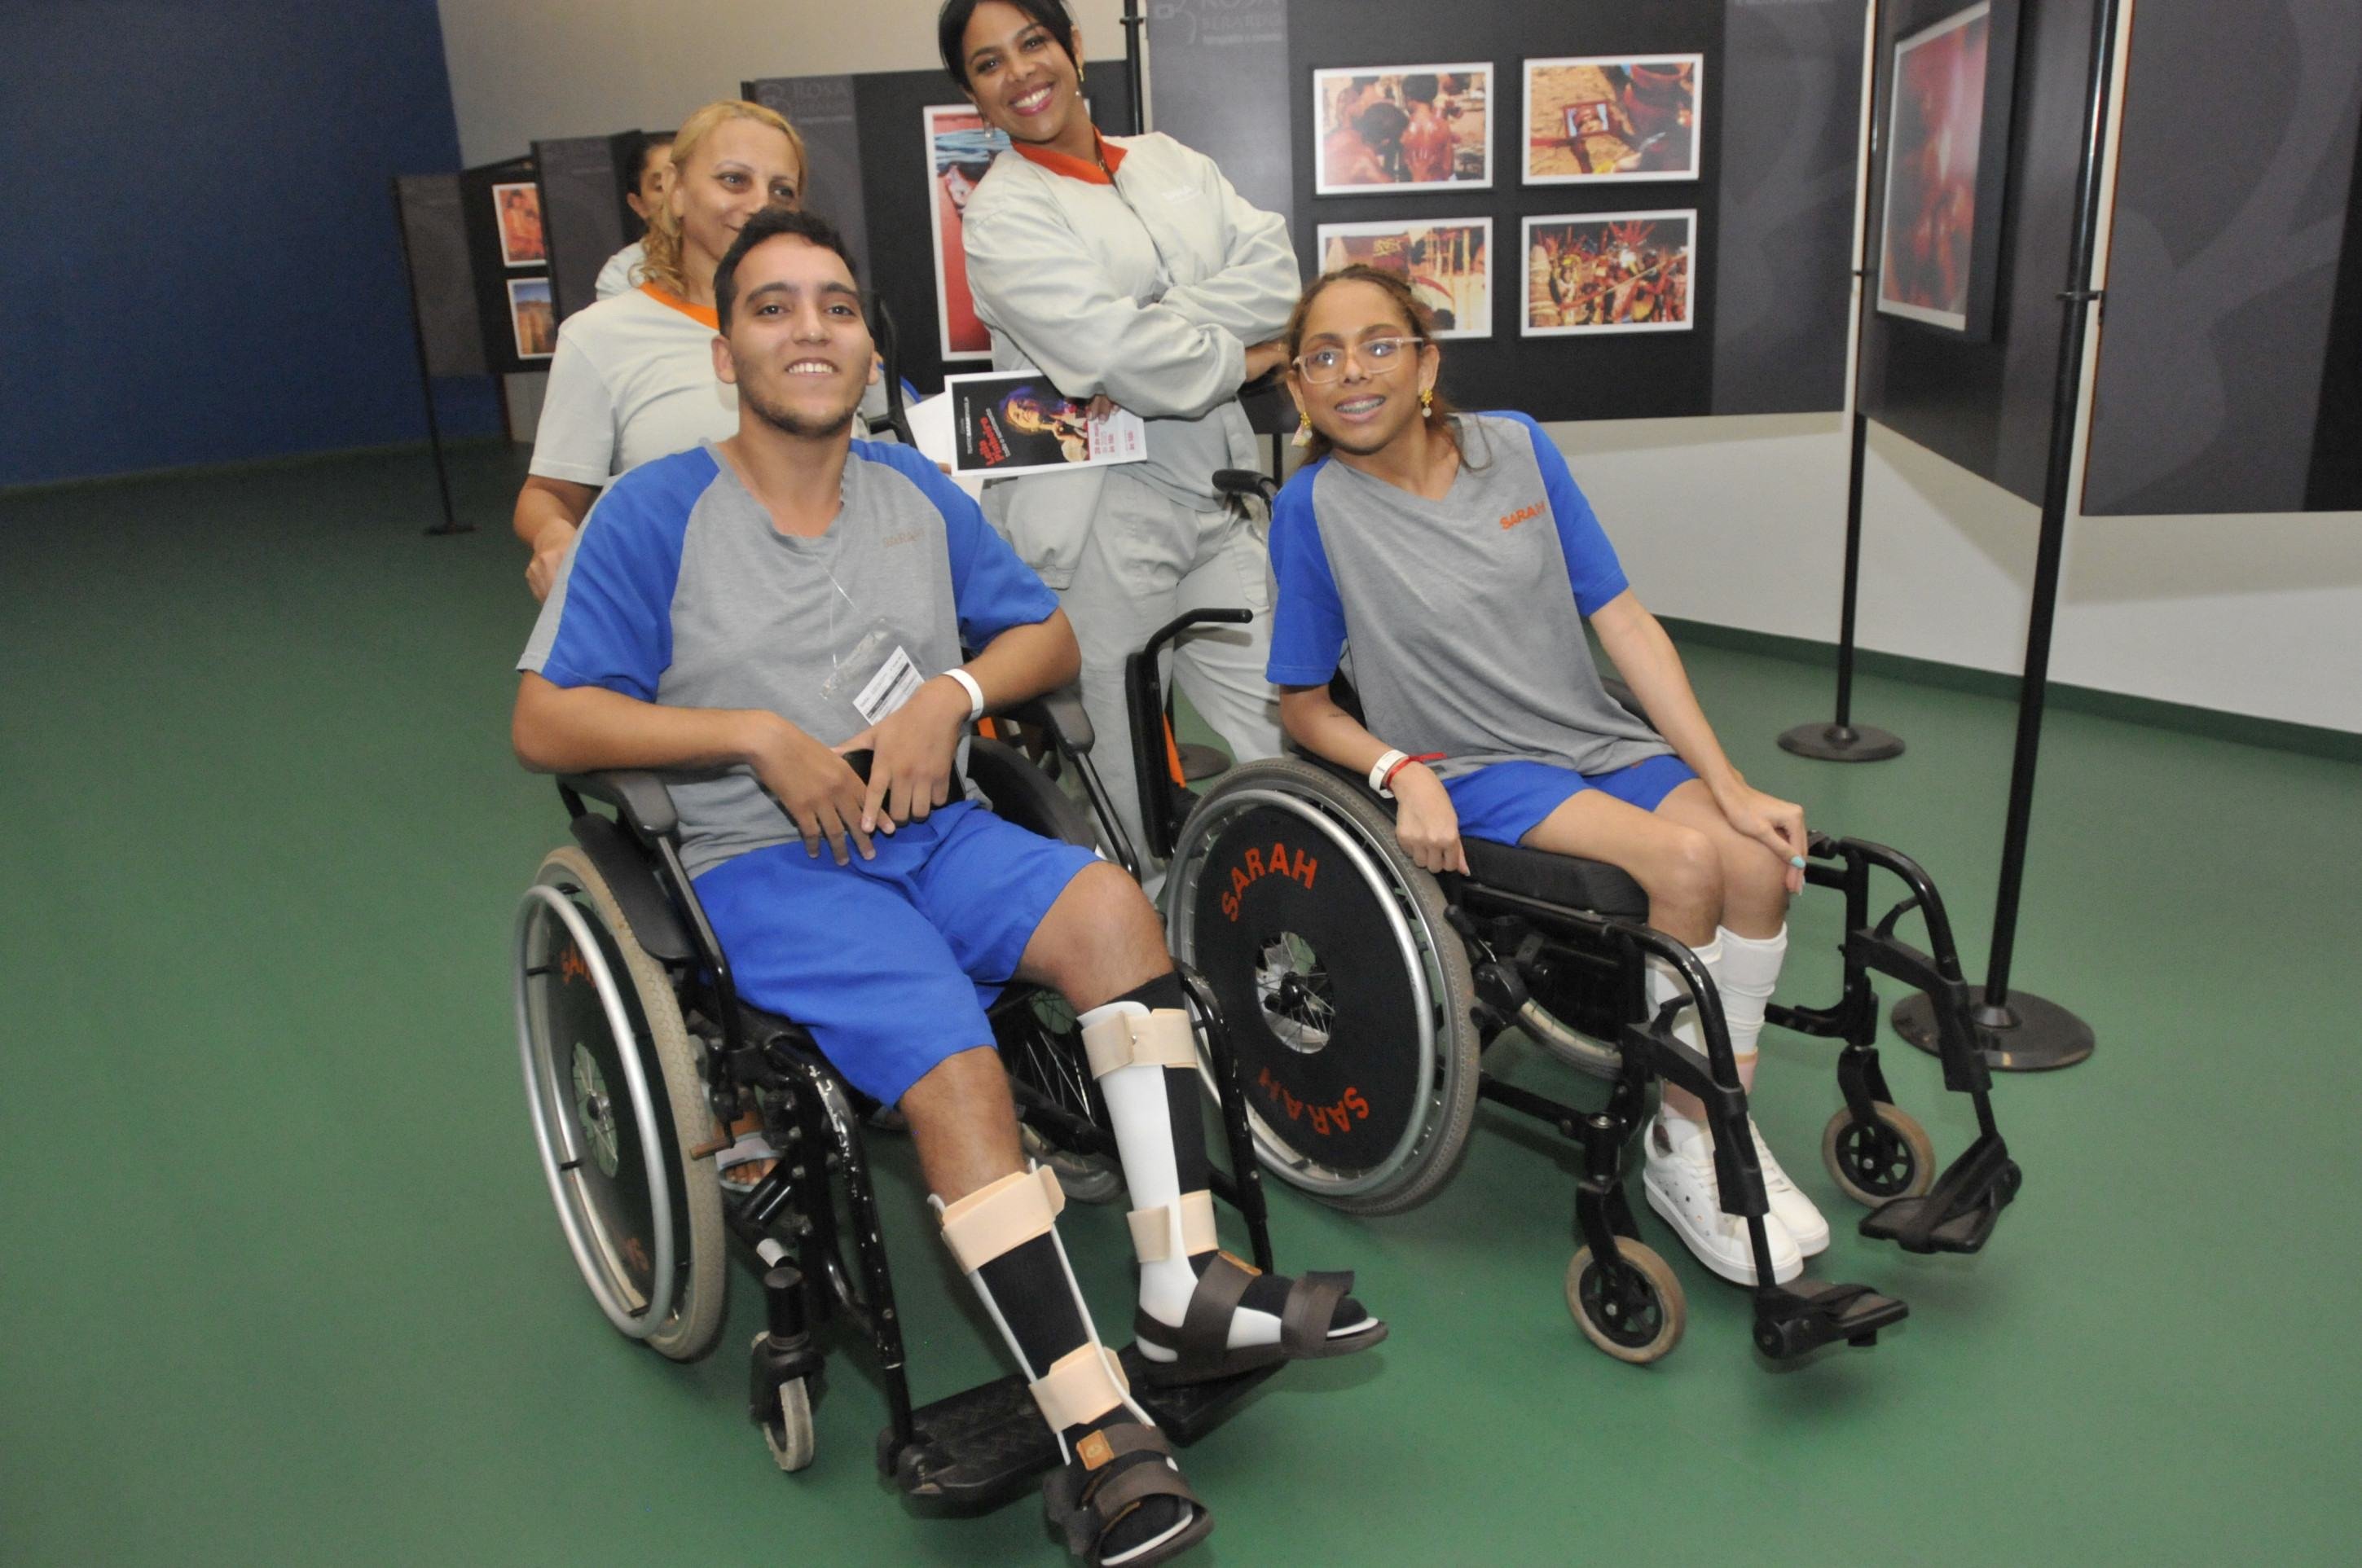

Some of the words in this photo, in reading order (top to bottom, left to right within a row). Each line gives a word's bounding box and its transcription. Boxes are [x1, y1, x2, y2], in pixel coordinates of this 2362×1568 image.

[980, 416, 1005, 462] Pinheiro
[1499, 500, 1546, 531] SARAH
[1221, 842, 1318, 923] SARAH
